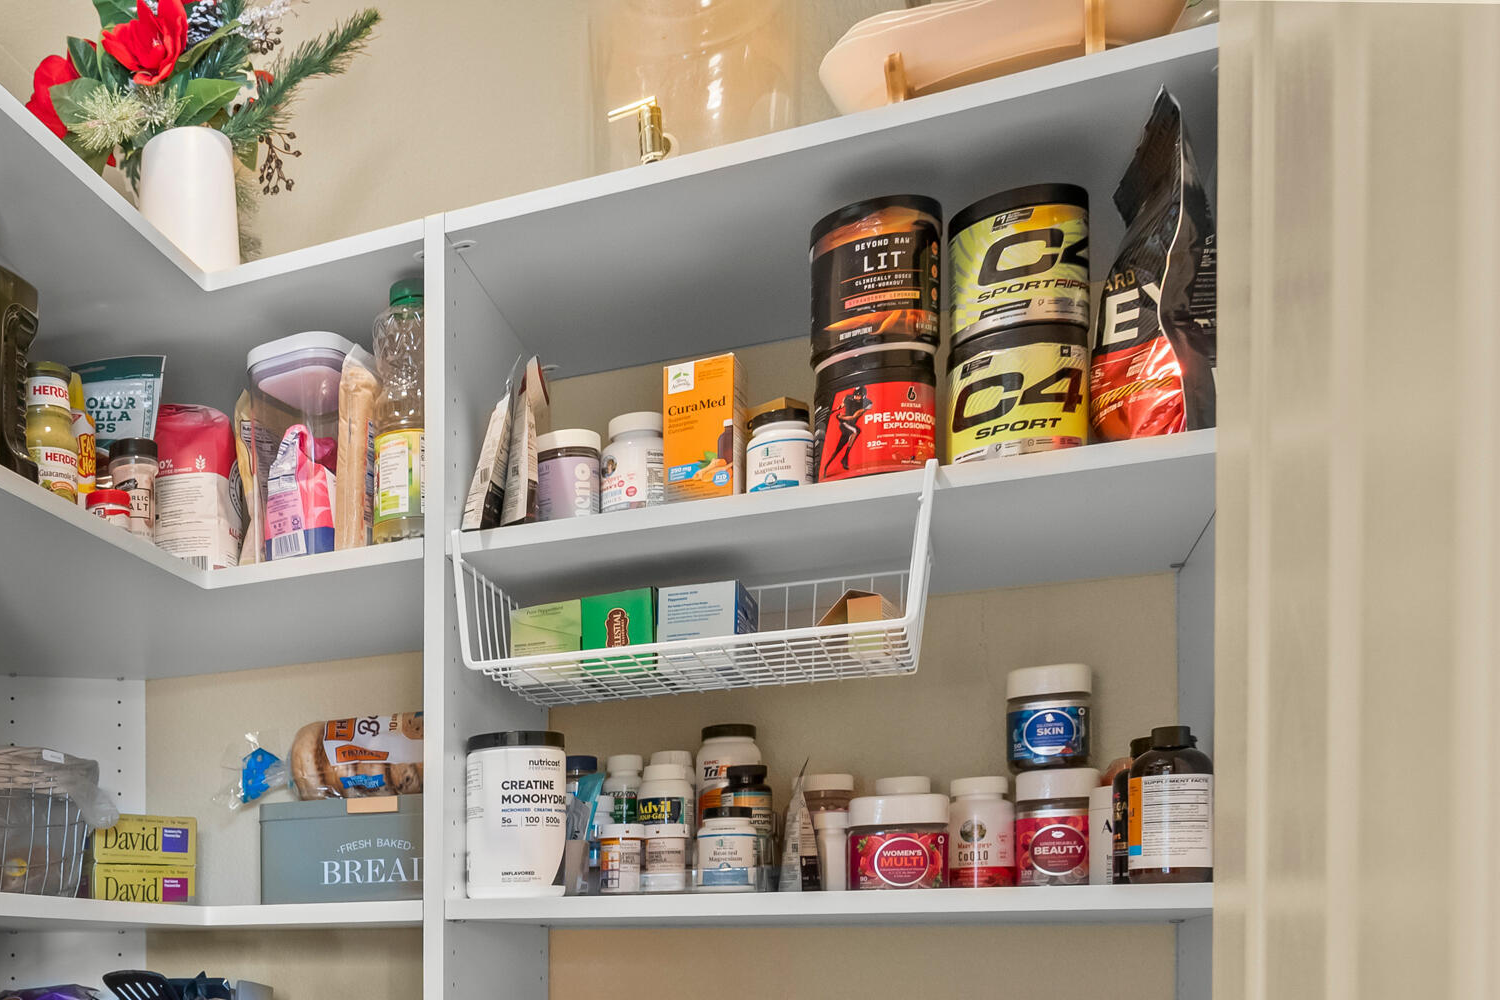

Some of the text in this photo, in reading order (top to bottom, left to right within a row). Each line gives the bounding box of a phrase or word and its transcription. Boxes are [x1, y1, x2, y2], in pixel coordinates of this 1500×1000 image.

[855, 237, 910, 252] BEYOND RAW
[864, 251, 901, 273] LIT
[855, 274, 891, 287] CLINICALLY
[863, 279, 904, 291] PRE-WORKOUT
[975, 279, 1054, 304] SPORT
[952, 367, 1083, 433] C4
[883, 422, 924, 430] EXPLOSION
[975, 417, 1062, 441] SPORT
[759, 457, 786, 468] Reacted
[39, 469, 72, 480] Guacamole
[754, 464, 792, 475] Magnesium
[1036, 726, 1064, 736] SKIN
[529, 758, 560, 767] nutricost
[501, 780, 554, 790] CREATINE
[639, 800, 671, 814] Advil
[545, 816, 560, 824] 500g
[103, 826, 159, 851] David
[340, 838, 411, 853] FRESH BAKED
[1034, 846, 1083, 856] BEAUTY
[882, 849, 922, 857] WOMEN'S
[958, 851, 989, 862] CoQ10
[708, 855, 743, 863] Magnesium
[880, 856, 924, 867] MULTI
[104, 876, 159, 902] David
